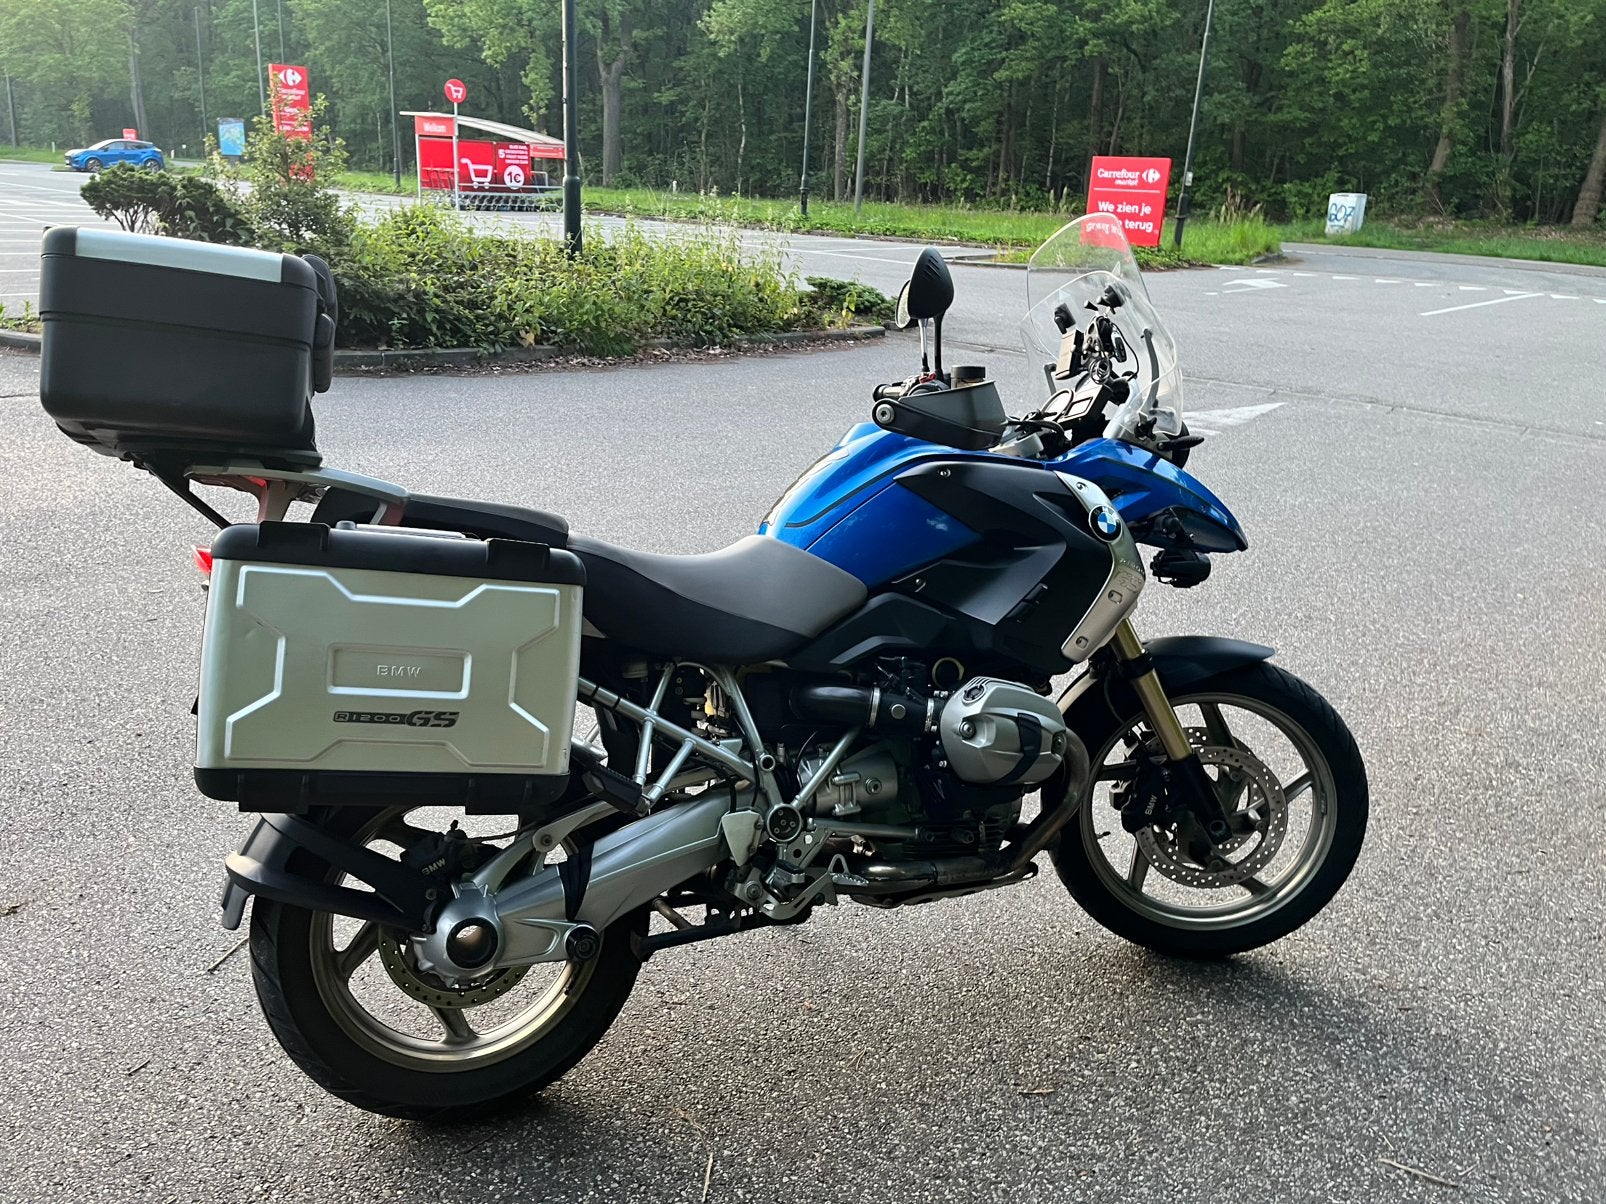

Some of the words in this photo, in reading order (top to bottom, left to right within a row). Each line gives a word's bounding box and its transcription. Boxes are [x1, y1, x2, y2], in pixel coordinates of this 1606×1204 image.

[498, 149, 505, 158] 5
[507, 171, 521, 184] 1€
[1097, 168, 1140, 178] Carrefour
[1097, 200, 1115, 212] We
[1116, 201, 1139, 213] zien
[1140, 203, 1151, 216] je
[1124, 218, 1154, 233] terug
[376, 664, 422, 678] BMW
[1144, 794, 1158, 815] BMW
